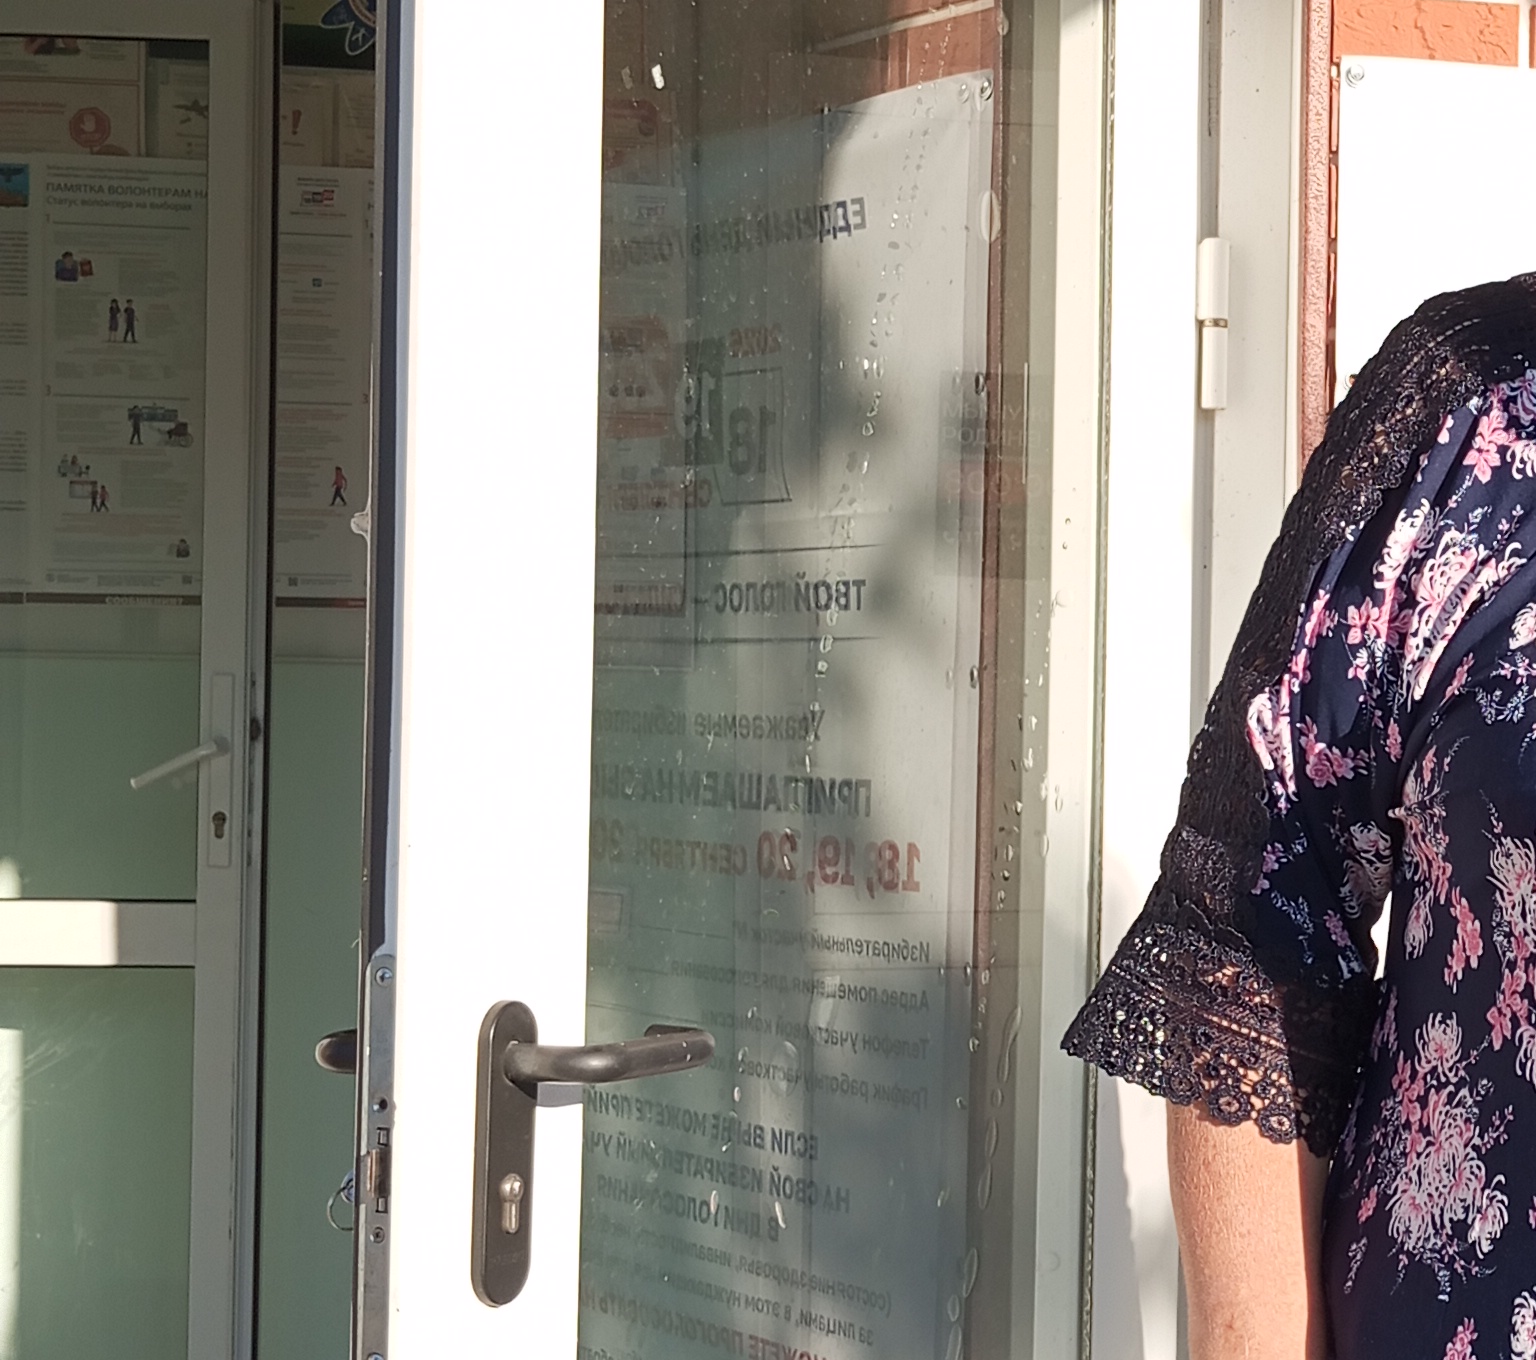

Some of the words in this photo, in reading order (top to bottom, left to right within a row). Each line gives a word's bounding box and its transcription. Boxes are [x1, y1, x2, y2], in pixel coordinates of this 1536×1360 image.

[46, 182, 105, 195] ПАМЯТКА
[108, 185, 191, 198] ВОЛОНТЕРАМ
[46, 195, 79, 208] Статус
